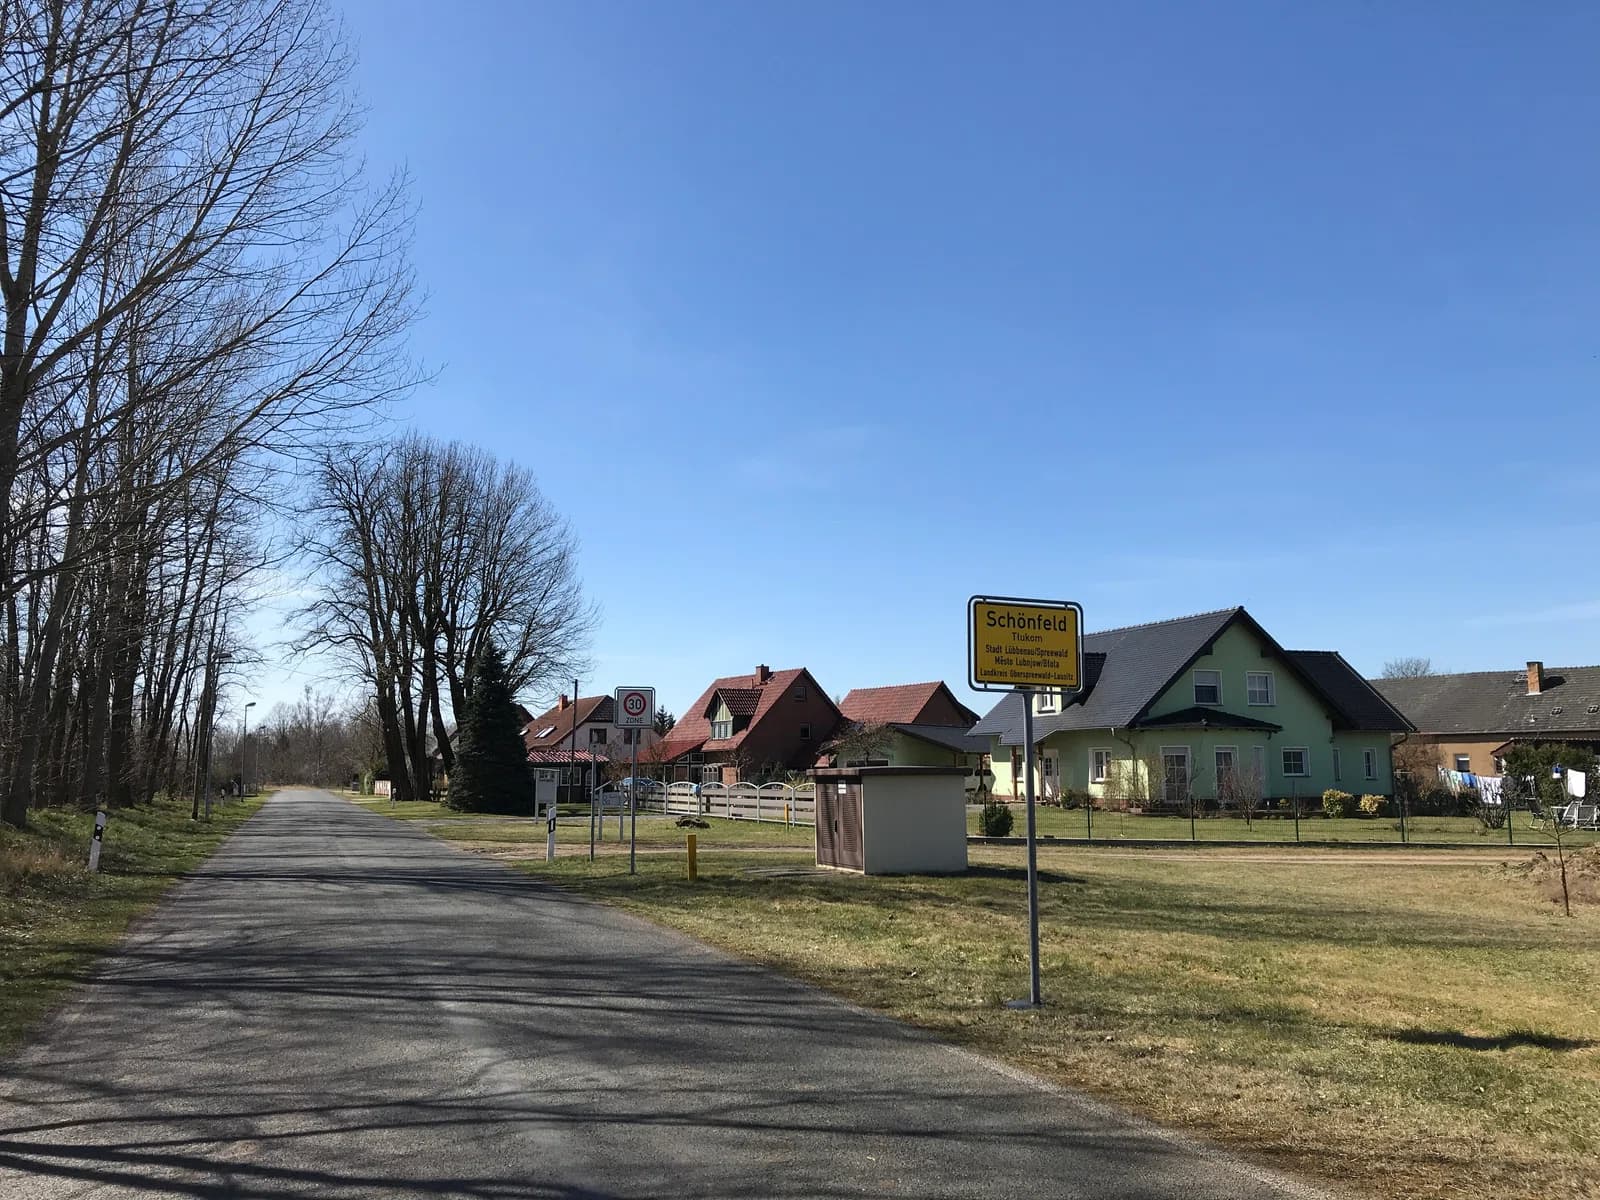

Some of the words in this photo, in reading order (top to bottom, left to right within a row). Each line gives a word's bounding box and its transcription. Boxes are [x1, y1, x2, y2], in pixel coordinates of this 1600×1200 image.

[986, 610, 1067, 632] Schönfeld
[985, 644, 1002, 653] Stadt
[1005, 645, 1068, 658] Lübbenau/Spreewald
[980, 668, 1008, 677] Landkreis
[1010, 669, 1074, 681] Oberspreewald-Lausitz
[628, 698, 642, 710] 30
